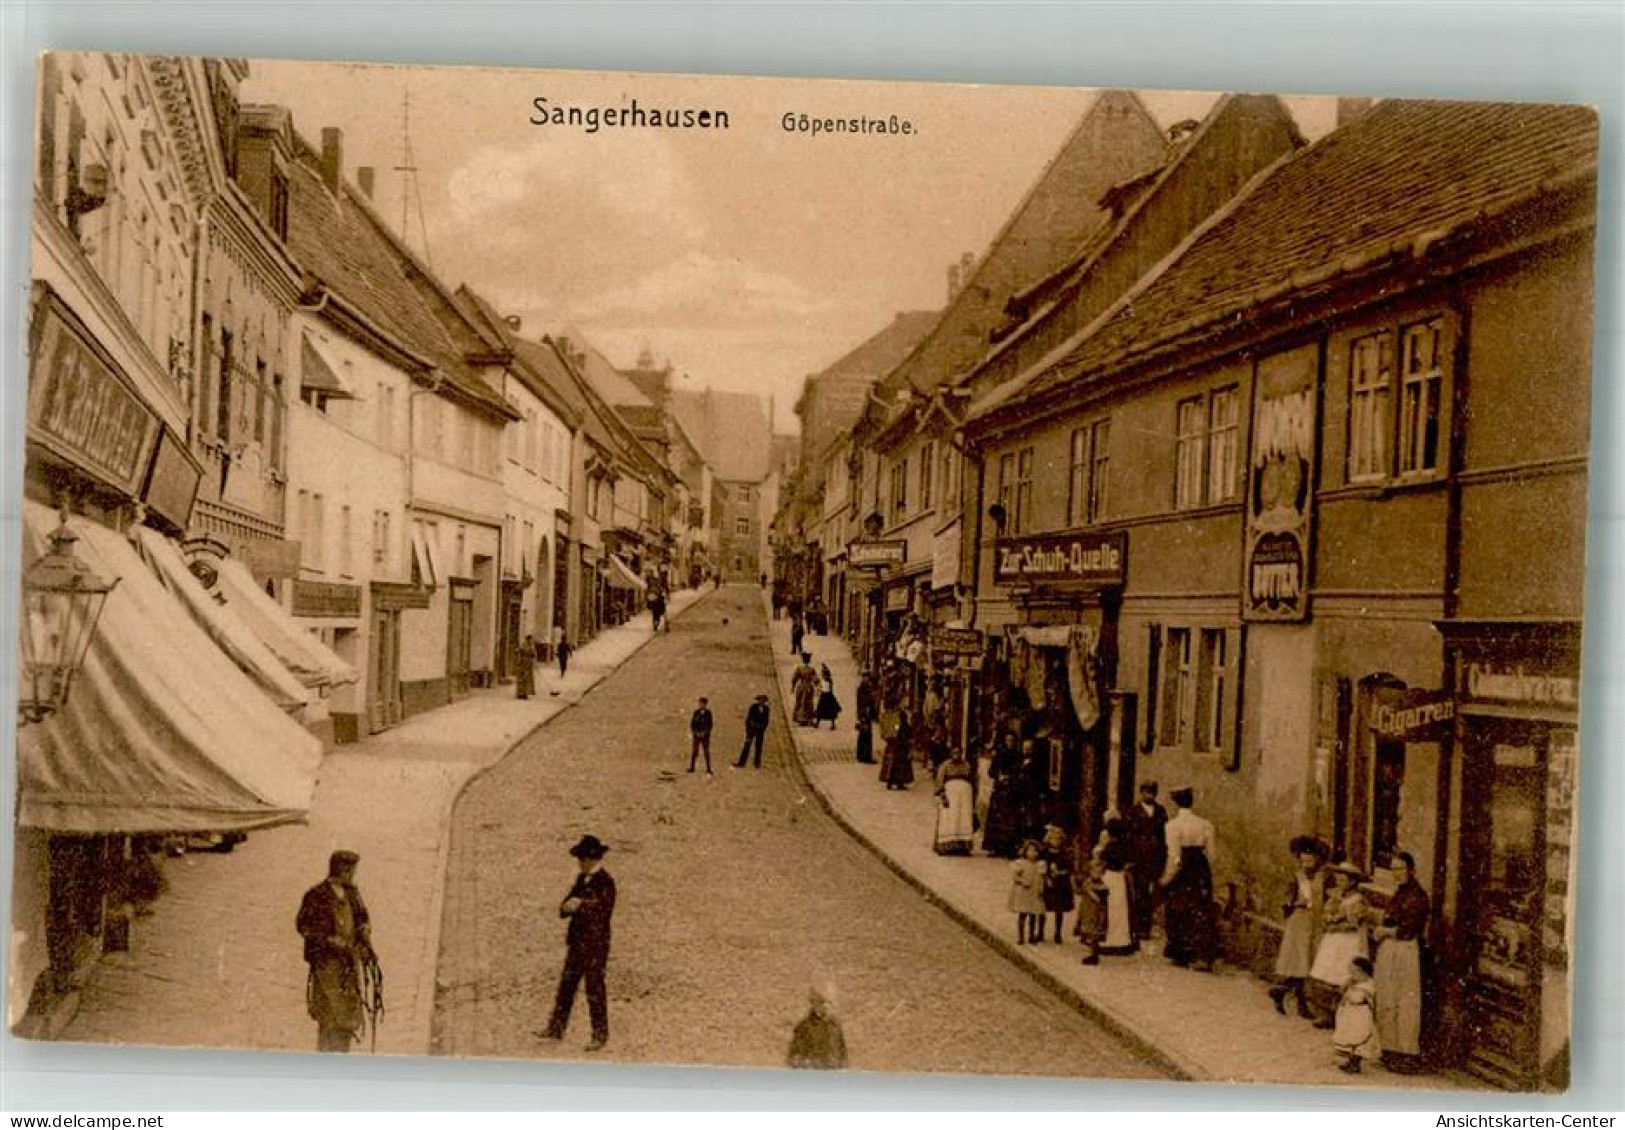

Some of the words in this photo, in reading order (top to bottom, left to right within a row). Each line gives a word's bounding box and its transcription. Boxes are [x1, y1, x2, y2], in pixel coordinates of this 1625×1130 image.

[1000, 548, 1022, 574] Zur
[1023, 542, 1120, 574] Schuh-Quelle
[1378, 701, 1454, 736] Cigarren
